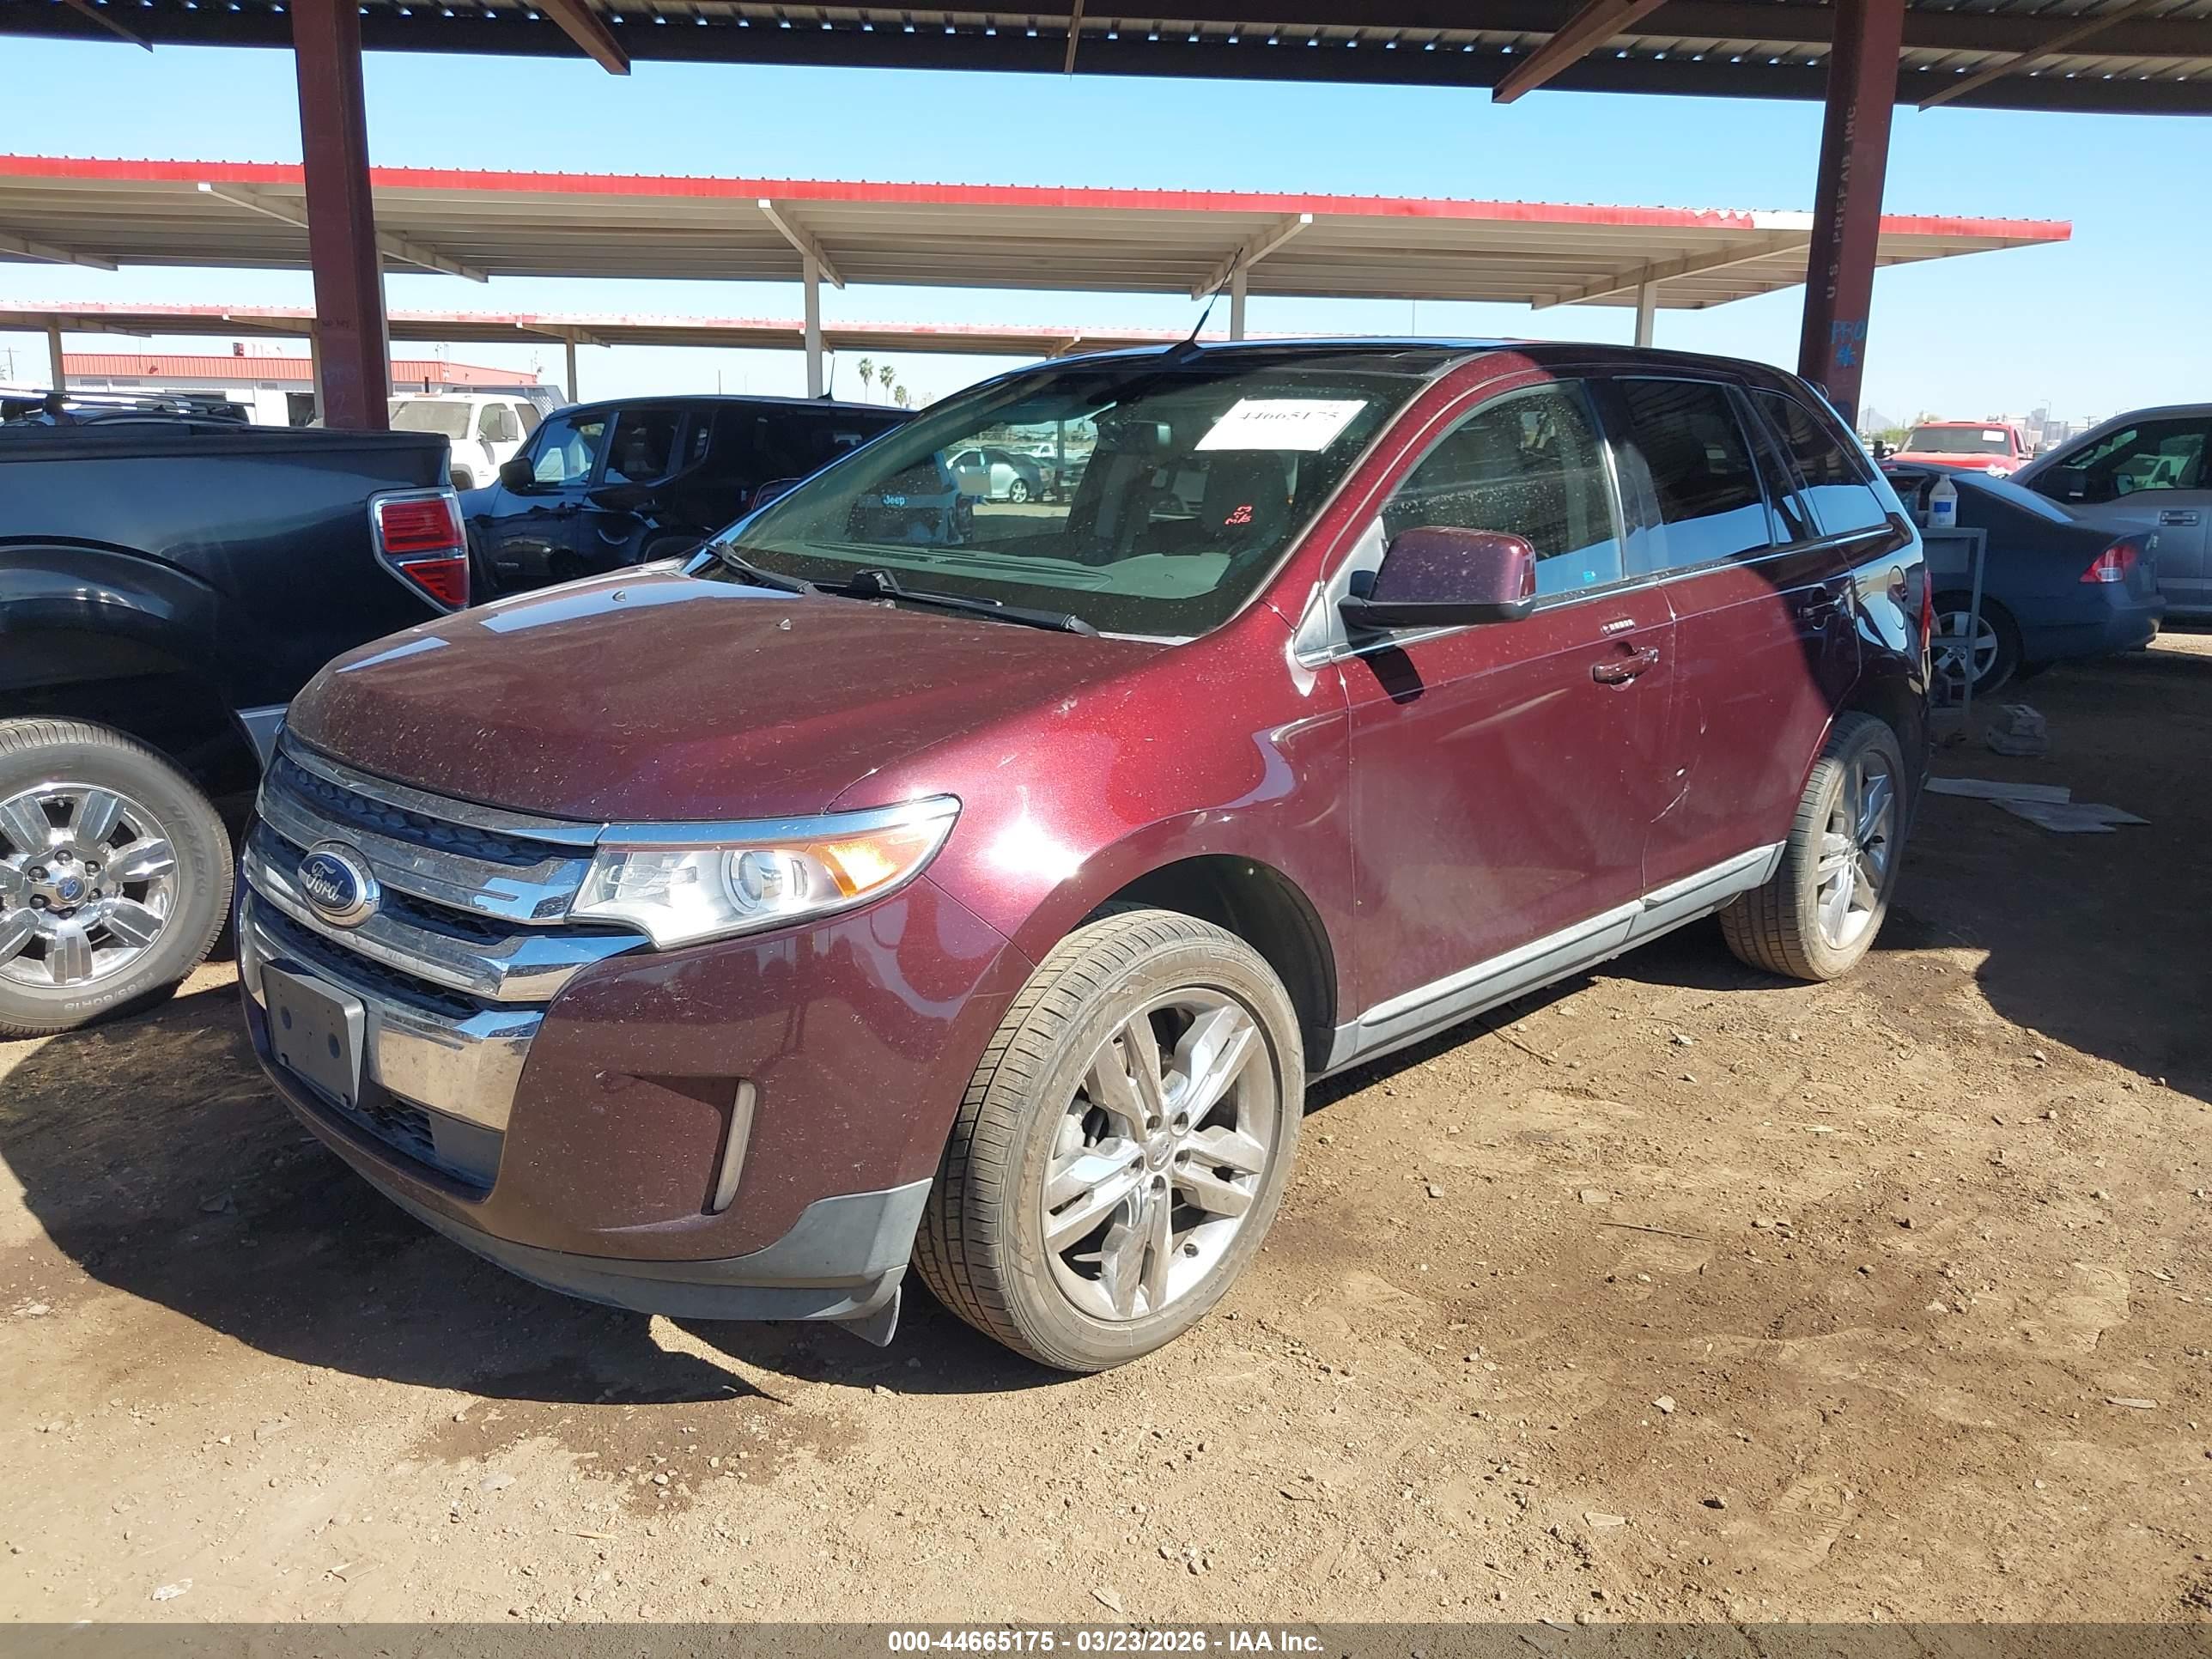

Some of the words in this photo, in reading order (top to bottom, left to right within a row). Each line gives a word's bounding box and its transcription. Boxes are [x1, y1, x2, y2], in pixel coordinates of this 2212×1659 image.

[1832, 155, 1851, 243] PREFAB
[883, 495, 906, 506] Jeep
[305, 860, 343, 902] Ford
